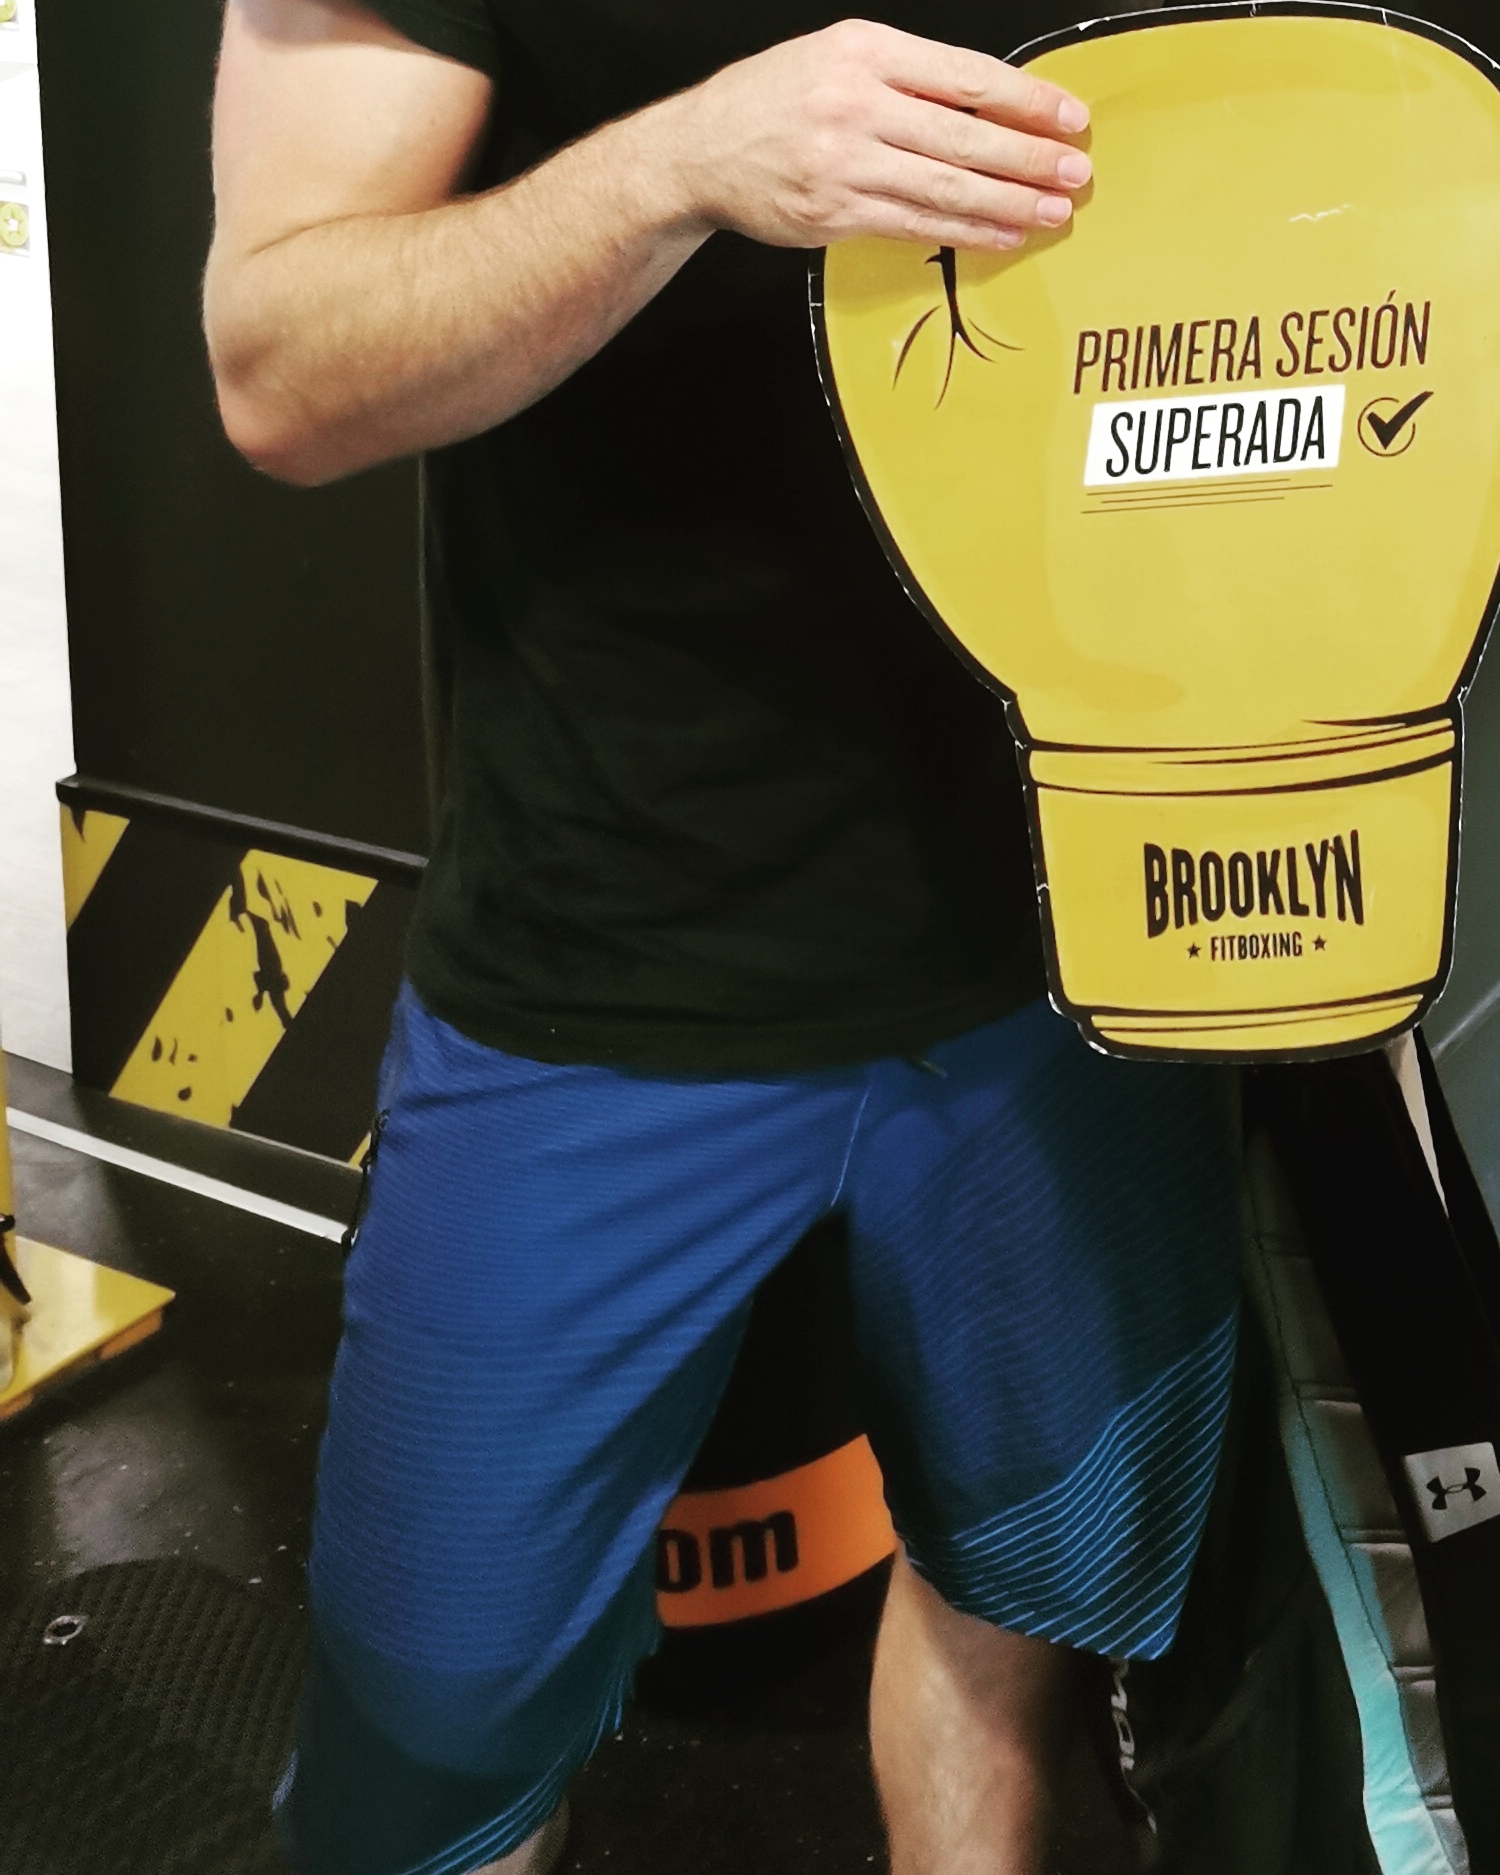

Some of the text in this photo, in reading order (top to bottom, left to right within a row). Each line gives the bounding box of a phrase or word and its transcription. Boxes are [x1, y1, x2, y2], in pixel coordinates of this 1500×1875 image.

[1073, 289, 1432, 395] PRIMERA SESIÓN
[1105, 395, 1326, 478] SUPERADA
[1143, 829, 1365, 939] BROOKLYN
[1211, 931, 1303, 961] FITBOXING
